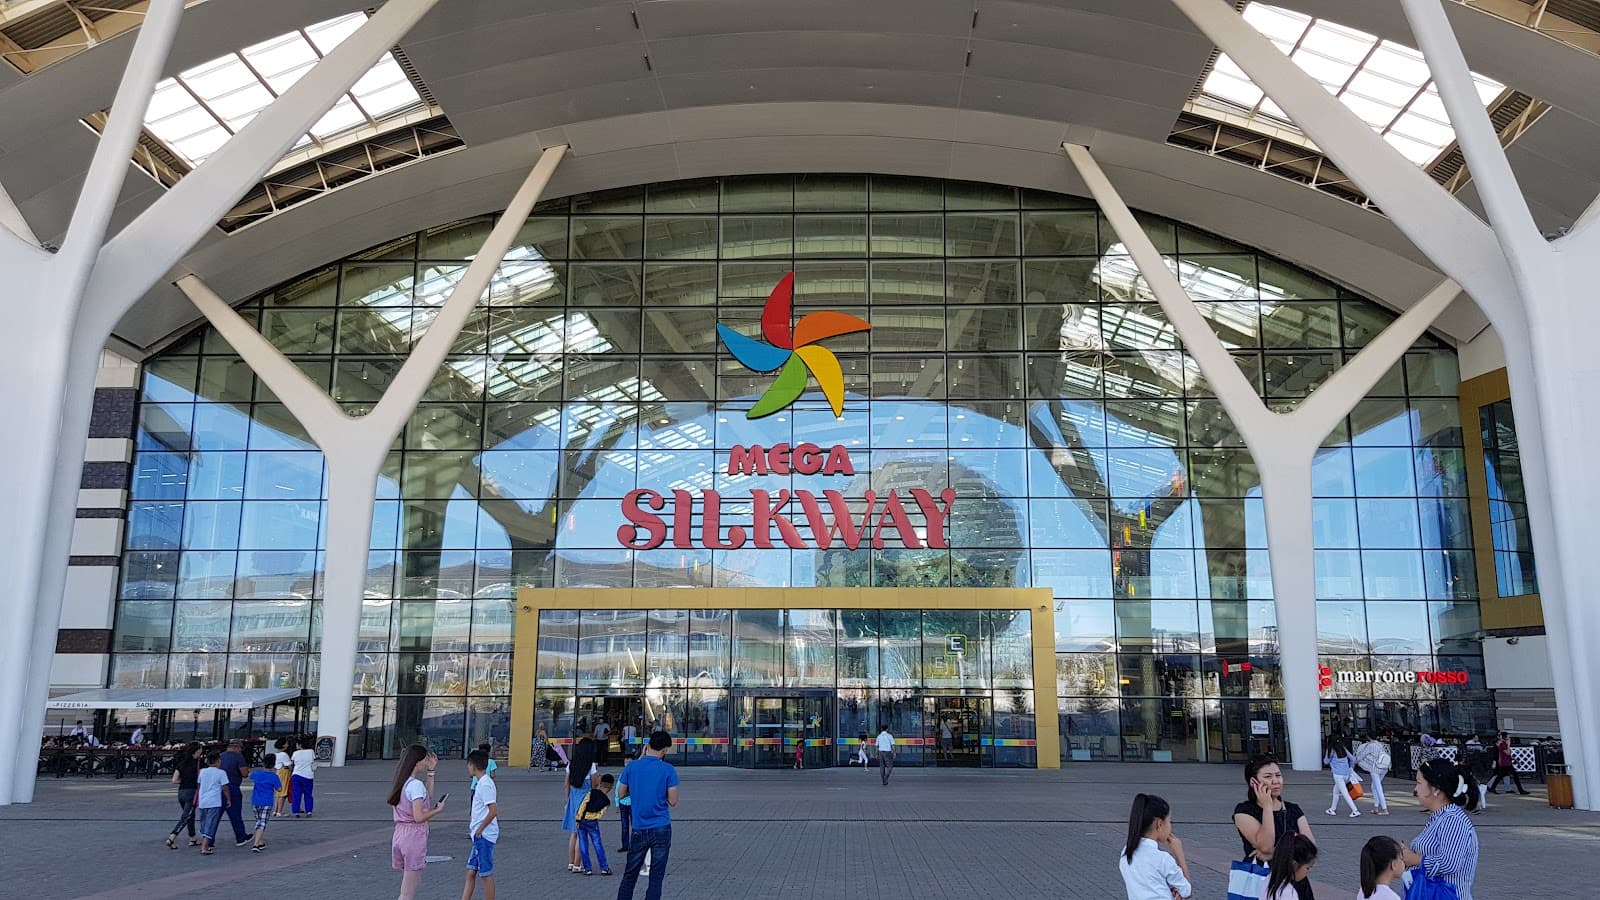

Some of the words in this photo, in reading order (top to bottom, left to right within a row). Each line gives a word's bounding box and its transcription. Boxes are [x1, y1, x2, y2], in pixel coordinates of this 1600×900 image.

[728, 443, 855, 475] MEGA
[617, 488, 956, 549] SILKWAY
[415, 664, 439, 672] SADU
